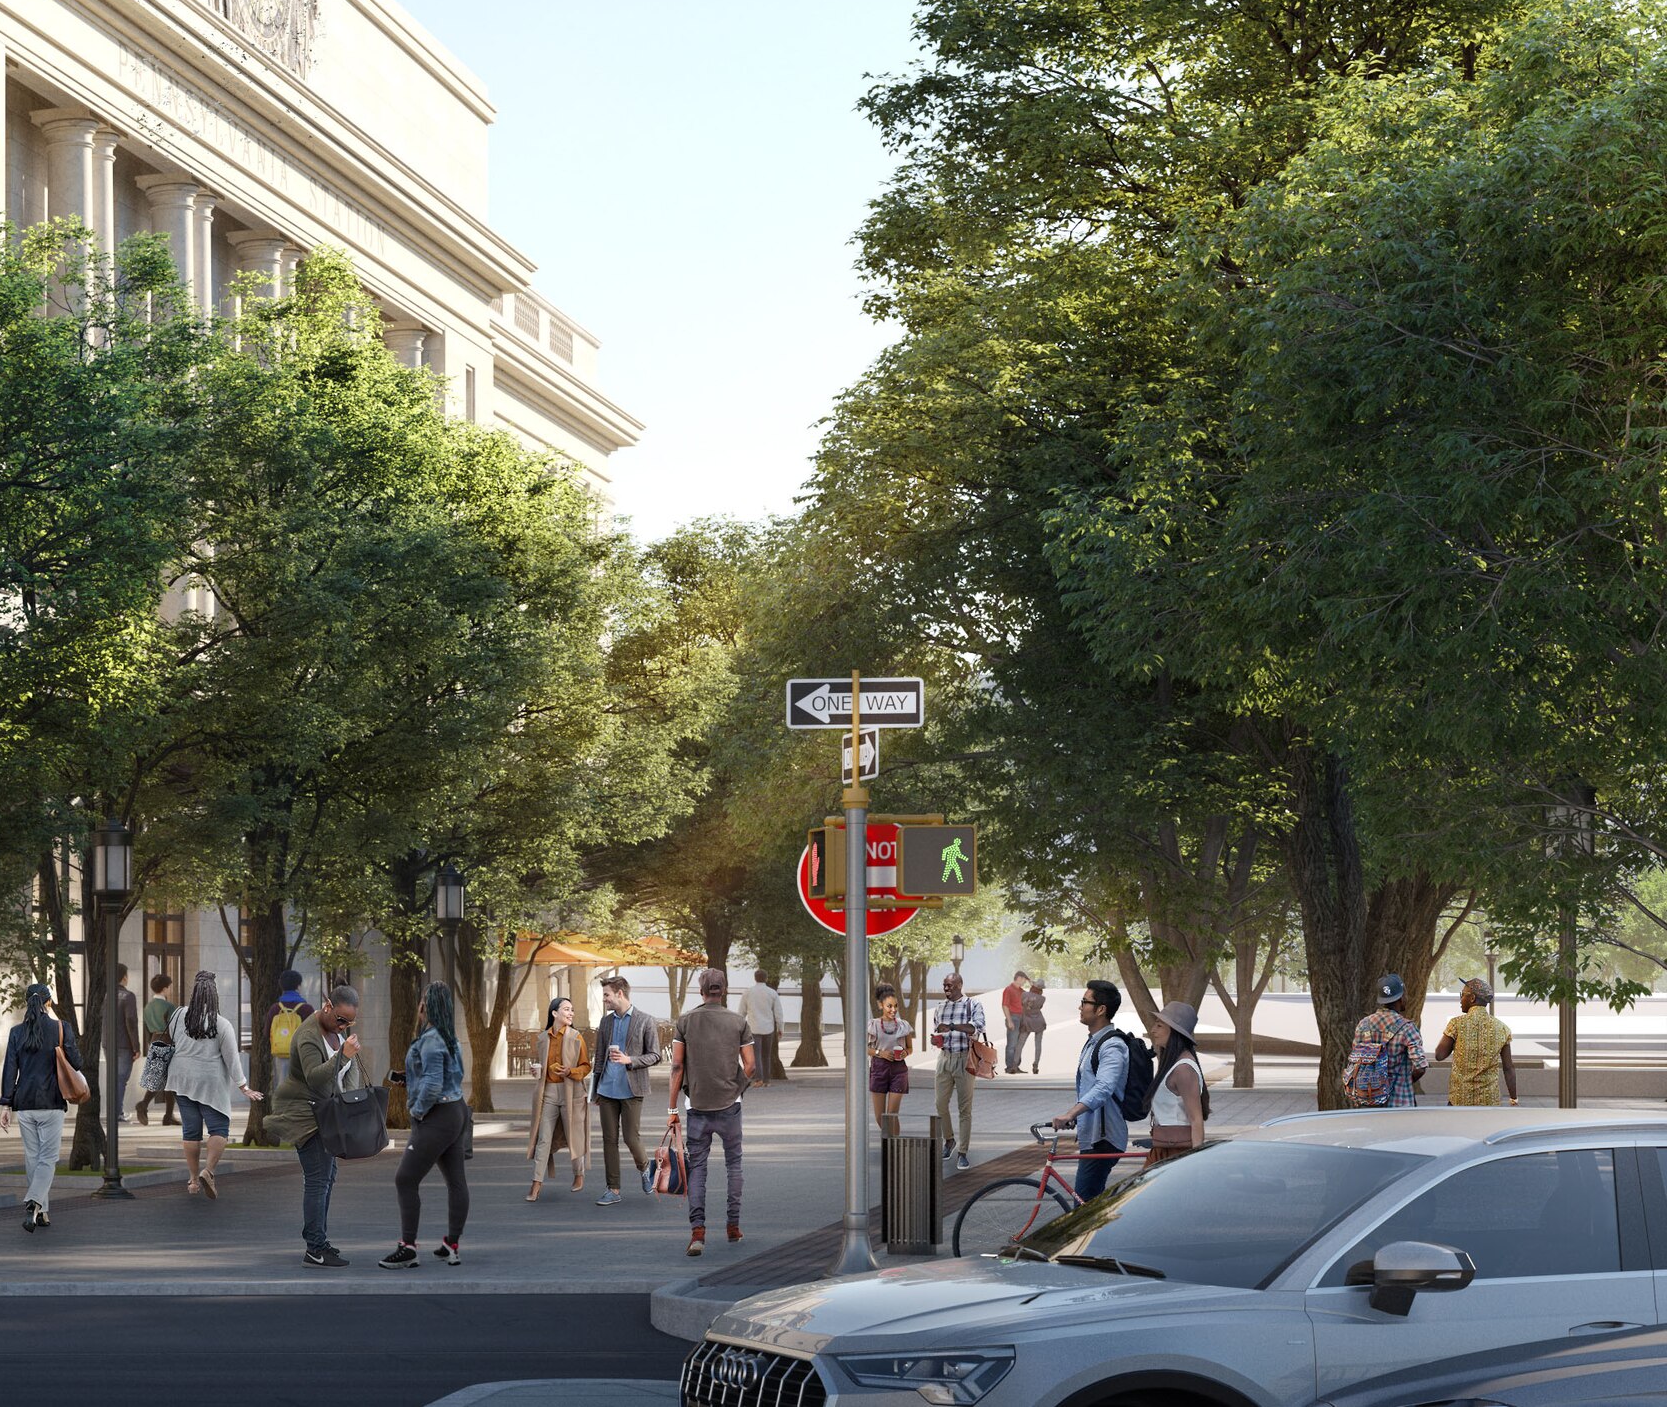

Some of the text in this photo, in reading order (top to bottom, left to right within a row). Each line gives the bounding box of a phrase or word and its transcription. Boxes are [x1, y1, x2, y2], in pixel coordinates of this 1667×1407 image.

[308, 177, 385, 255] STATION
[811, 695, 908, 712] ONE WAY
[866, 841, 897, 860] NOT
